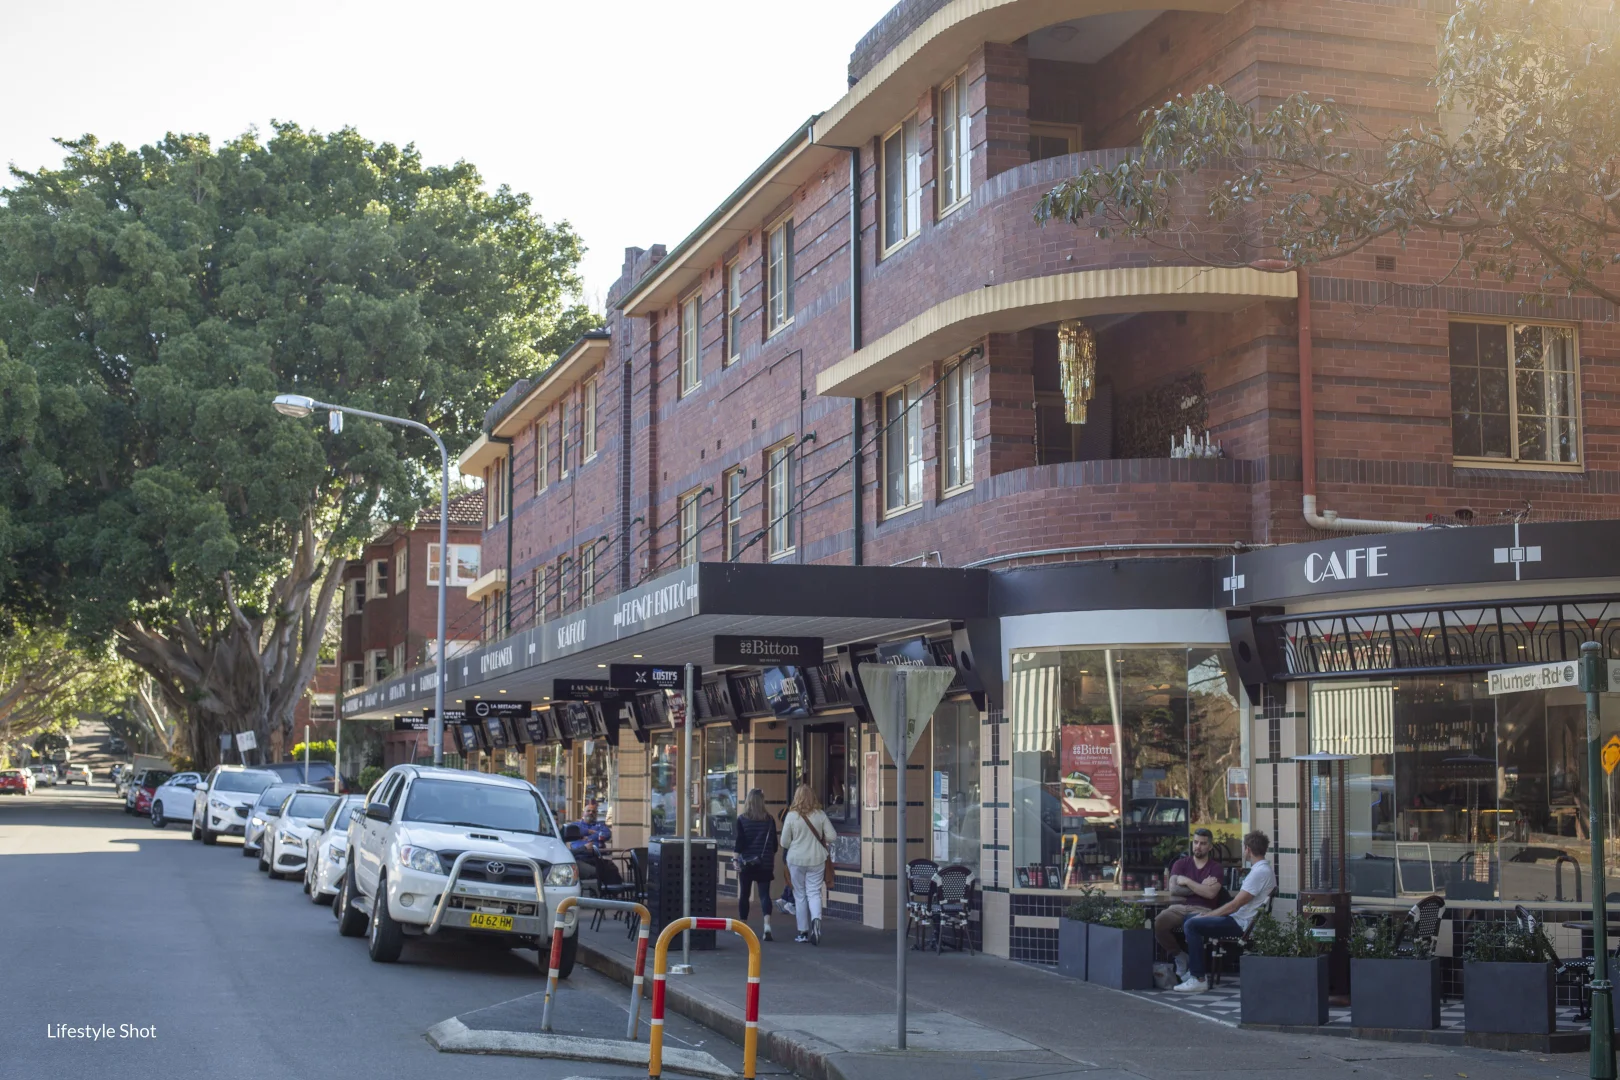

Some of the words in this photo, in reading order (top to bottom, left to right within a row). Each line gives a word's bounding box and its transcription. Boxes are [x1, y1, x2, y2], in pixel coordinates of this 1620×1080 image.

[1304, 546, 1389, 584] CAFE
[622, 592, 654, 627] FRENCH
[655, 580, 687, 616] BISTRO
[557, 619, 587, 649] SEAFOOD
[752, 640, 799, 655] Bitton
[1491, 673, 1536, 691] Plumer
[1541, 666, 1559, 685] Rd
[1081, 744, 1112, 755] Bitton
[486, 916, 498, 926] 62
[500, 916, 512, 928] HM
